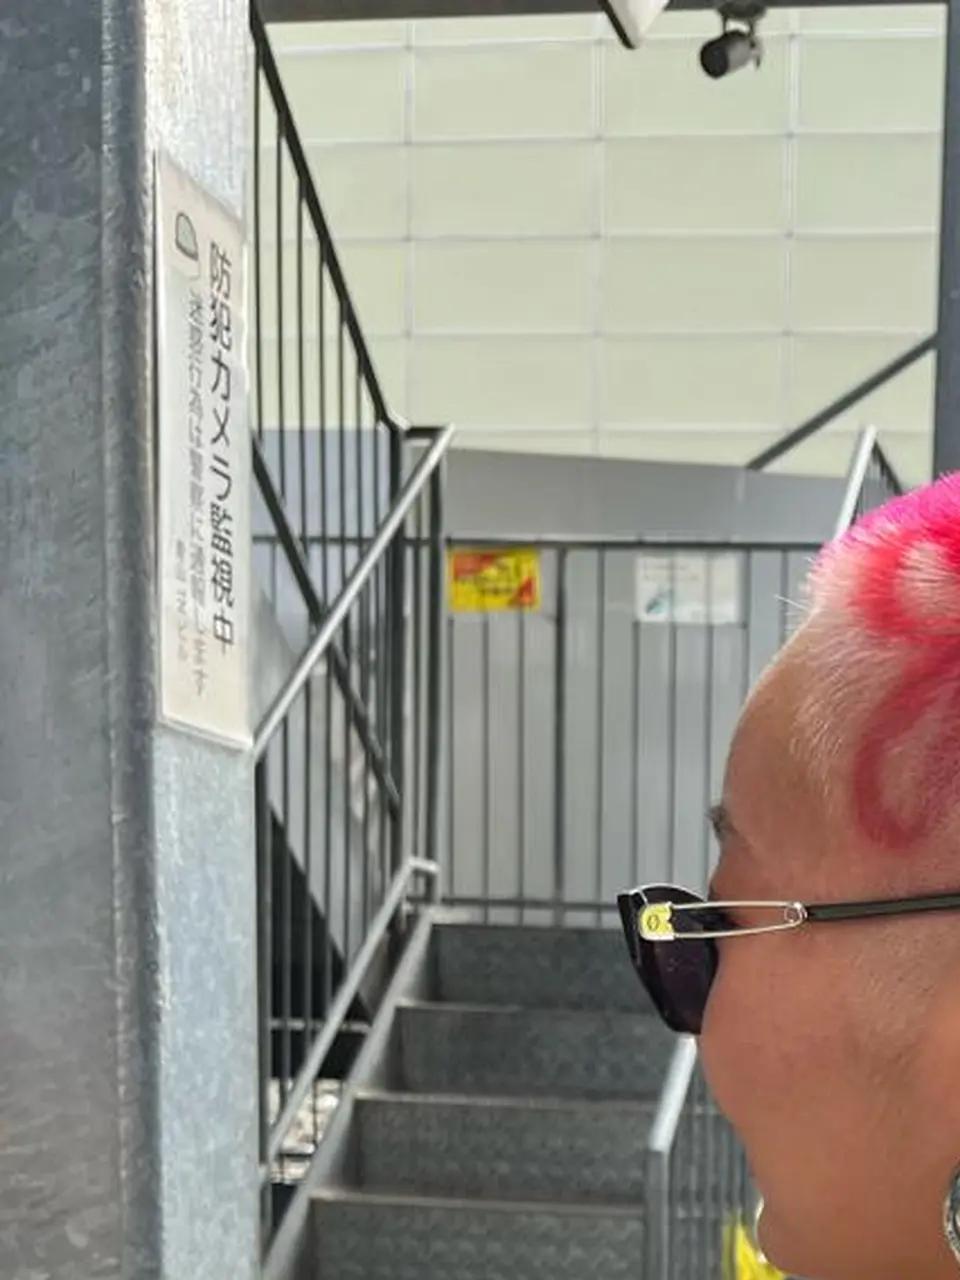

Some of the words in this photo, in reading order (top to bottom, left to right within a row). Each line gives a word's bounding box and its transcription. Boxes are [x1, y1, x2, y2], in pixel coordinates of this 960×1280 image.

[210, 242, 234, 654] 防犯カメラ監視中
